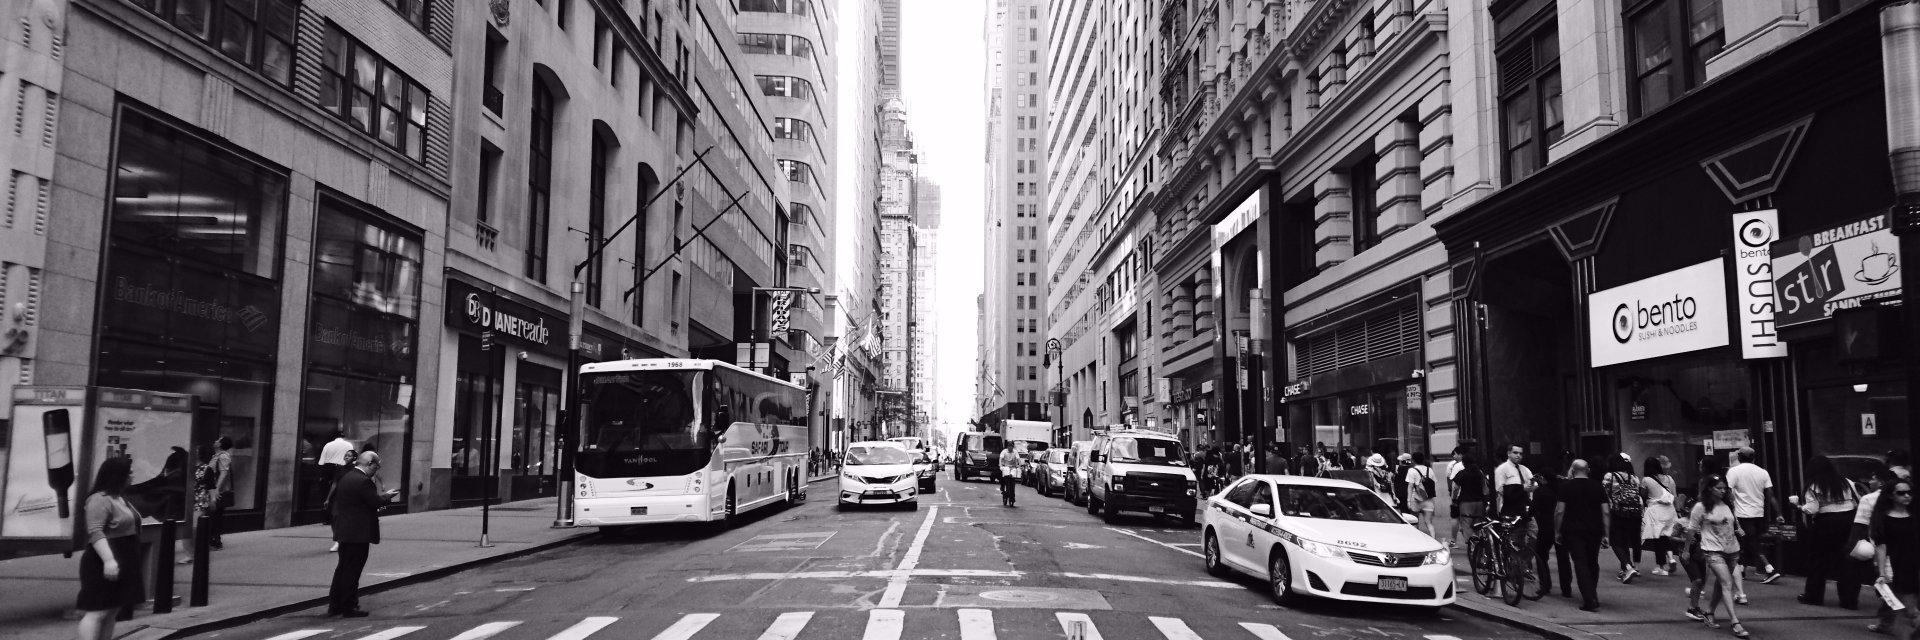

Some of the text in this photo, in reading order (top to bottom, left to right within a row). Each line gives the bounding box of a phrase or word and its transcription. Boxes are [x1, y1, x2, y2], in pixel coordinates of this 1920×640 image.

[1813, 215, 1885, 246] BREAKFAST
[1637, 293, 1696, 329] bento
[1747, 263, 1777, 347] SUSHI
[1638, 322, 1698, 341] SUSHI & NOODLES
[33, 390, 66, 399] TITAN
[1284, 383, 1302, 396] CHASE
[1350, 404, 1369, 416] CHASE
[1865, 416, 1873, 429] A
[752, 441, 768, 455] SAFARI
[1337, 540, 1367, 548] 8692
